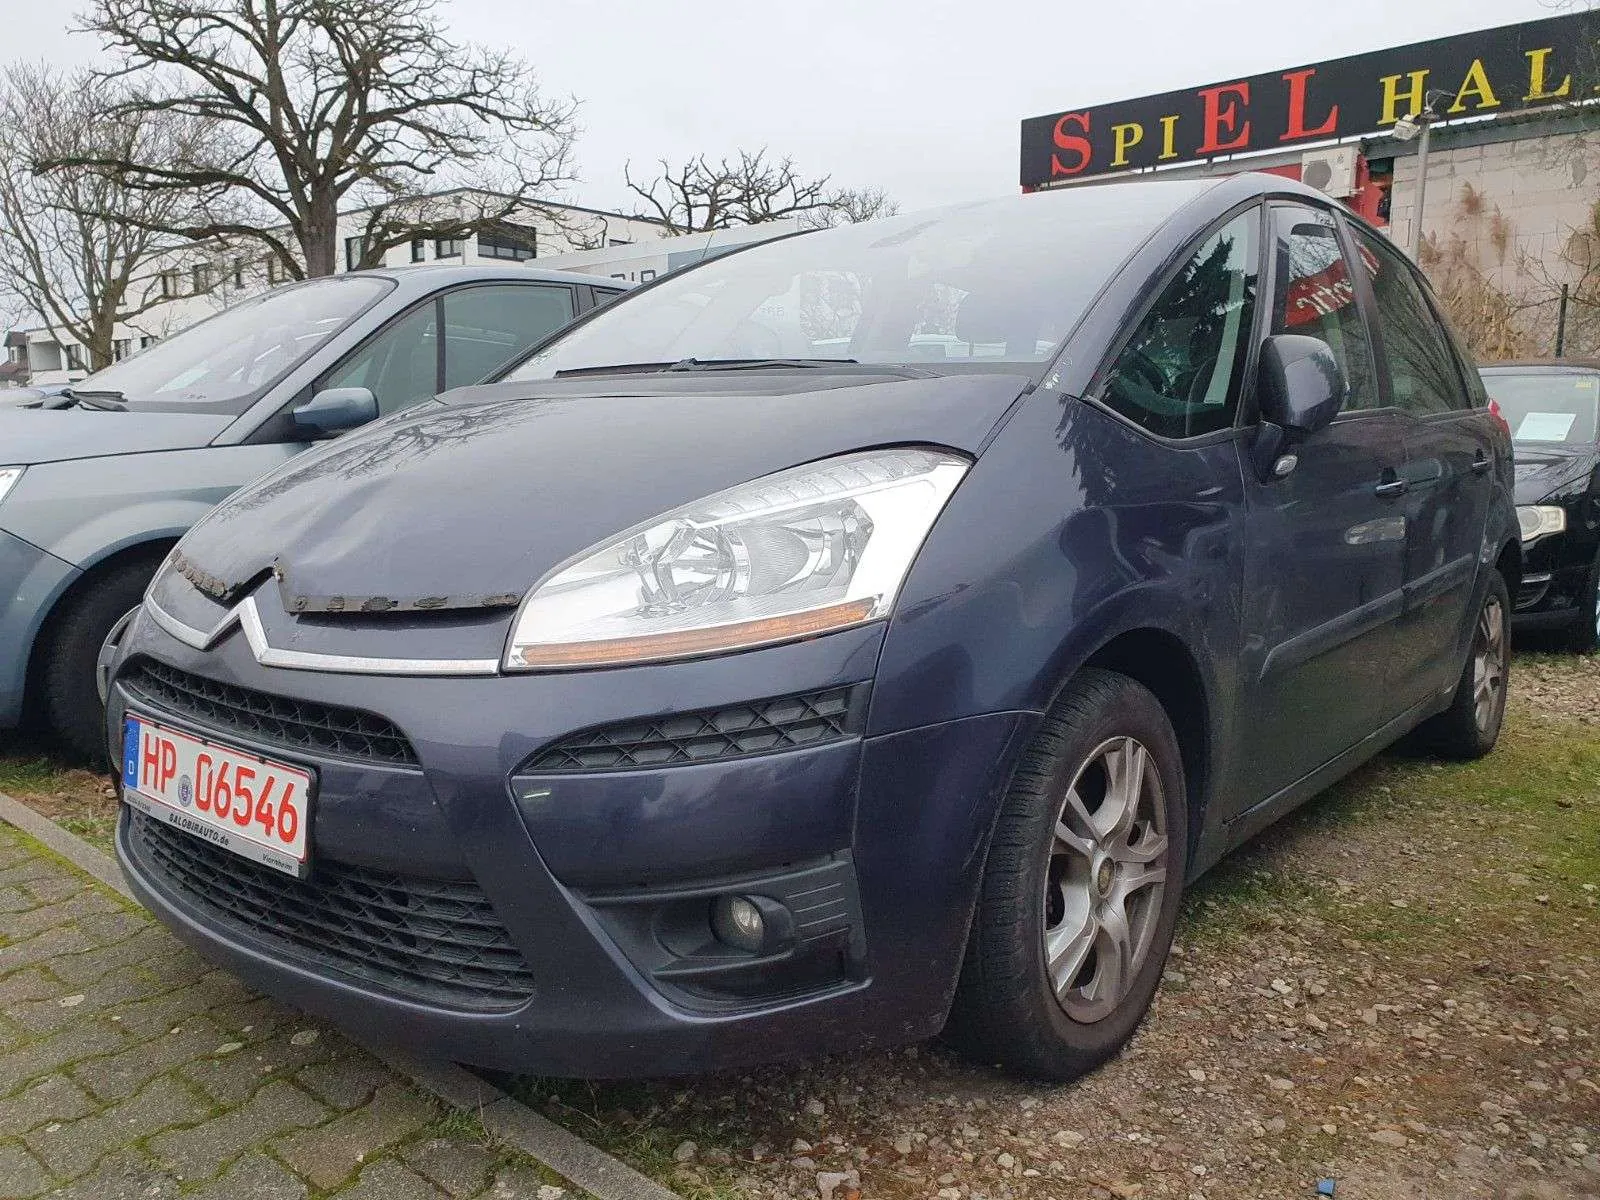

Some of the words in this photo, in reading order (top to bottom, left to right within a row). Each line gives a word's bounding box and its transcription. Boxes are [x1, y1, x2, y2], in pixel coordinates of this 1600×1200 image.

[1051, 68, 1339, 175] SPIEL
[1378, 47, 1600, 126] HAL
[128, 760, 135, 775] D
[143, 732, 177, 793] HP
[194, 753, 298, 844] 06546
